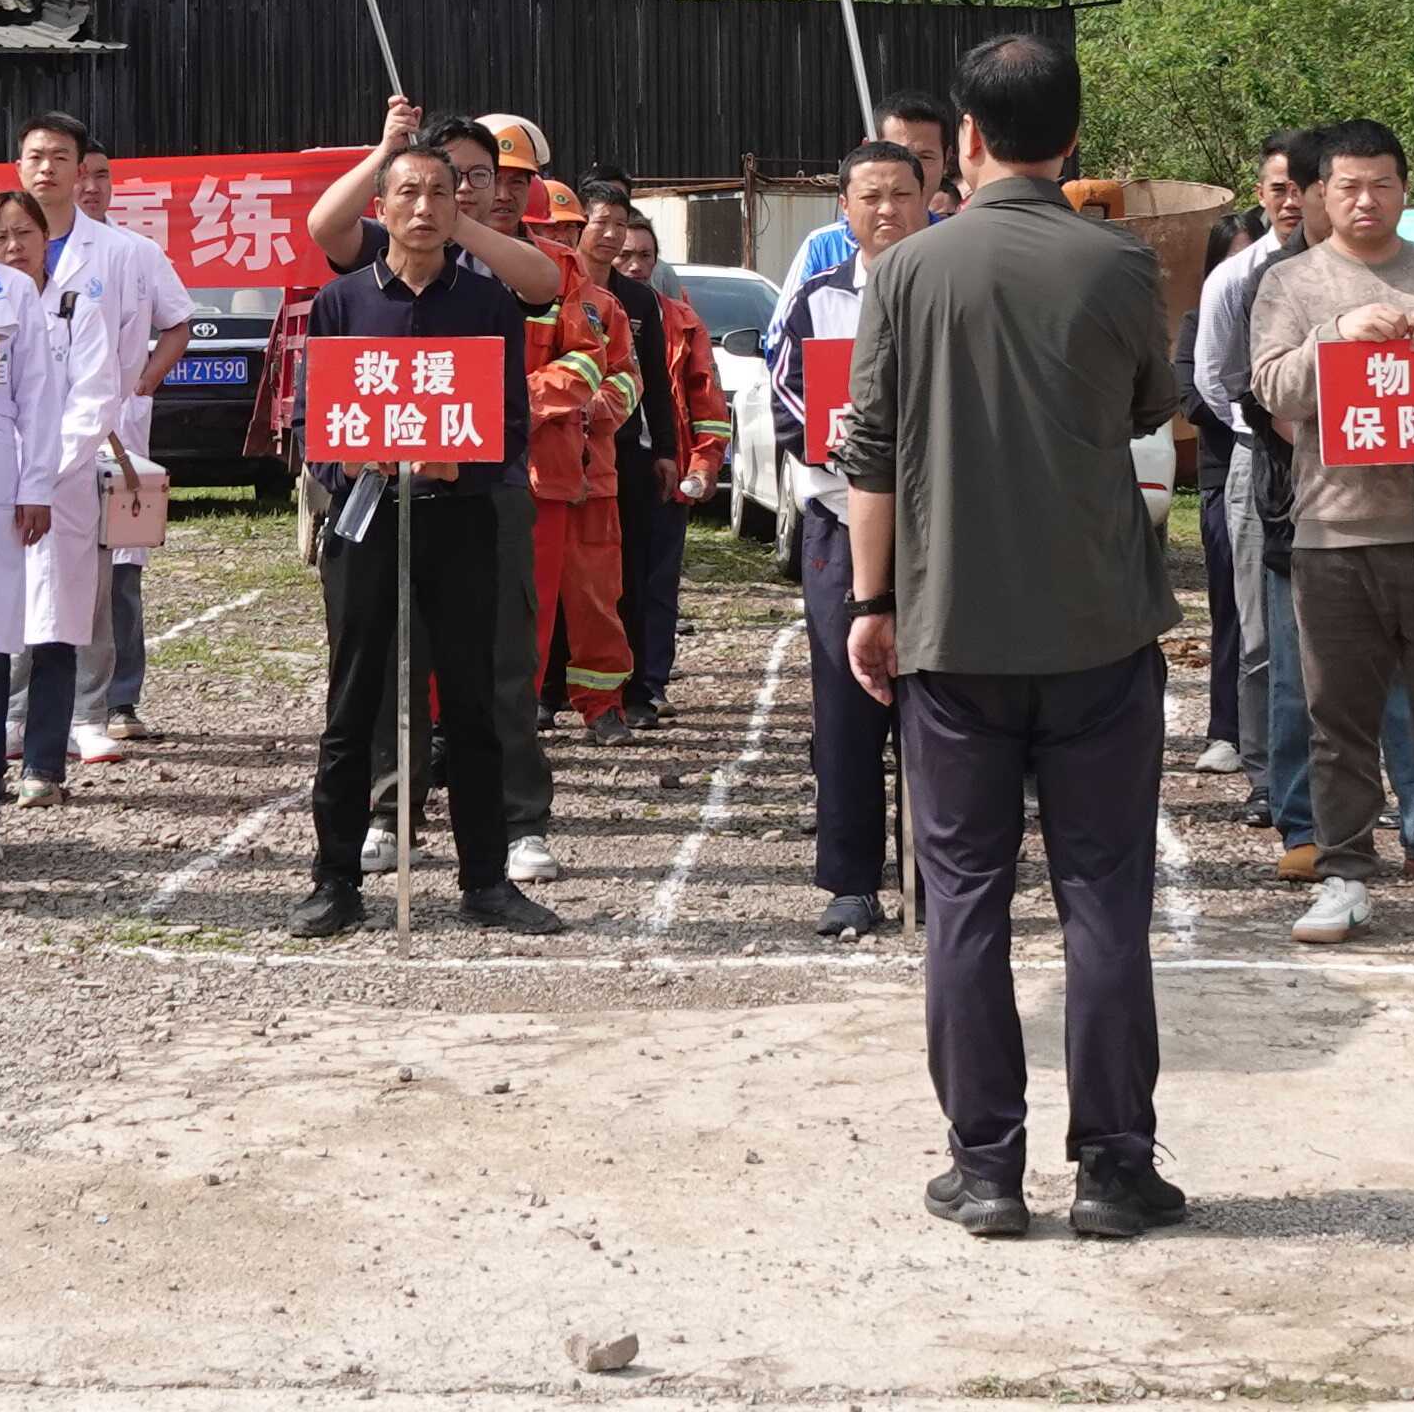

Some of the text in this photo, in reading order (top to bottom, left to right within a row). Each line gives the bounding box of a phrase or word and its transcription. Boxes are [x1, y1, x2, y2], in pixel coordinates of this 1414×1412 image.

[354, 350, 455, 395] 救援
[326, 402, 483, 447] 抢险队
